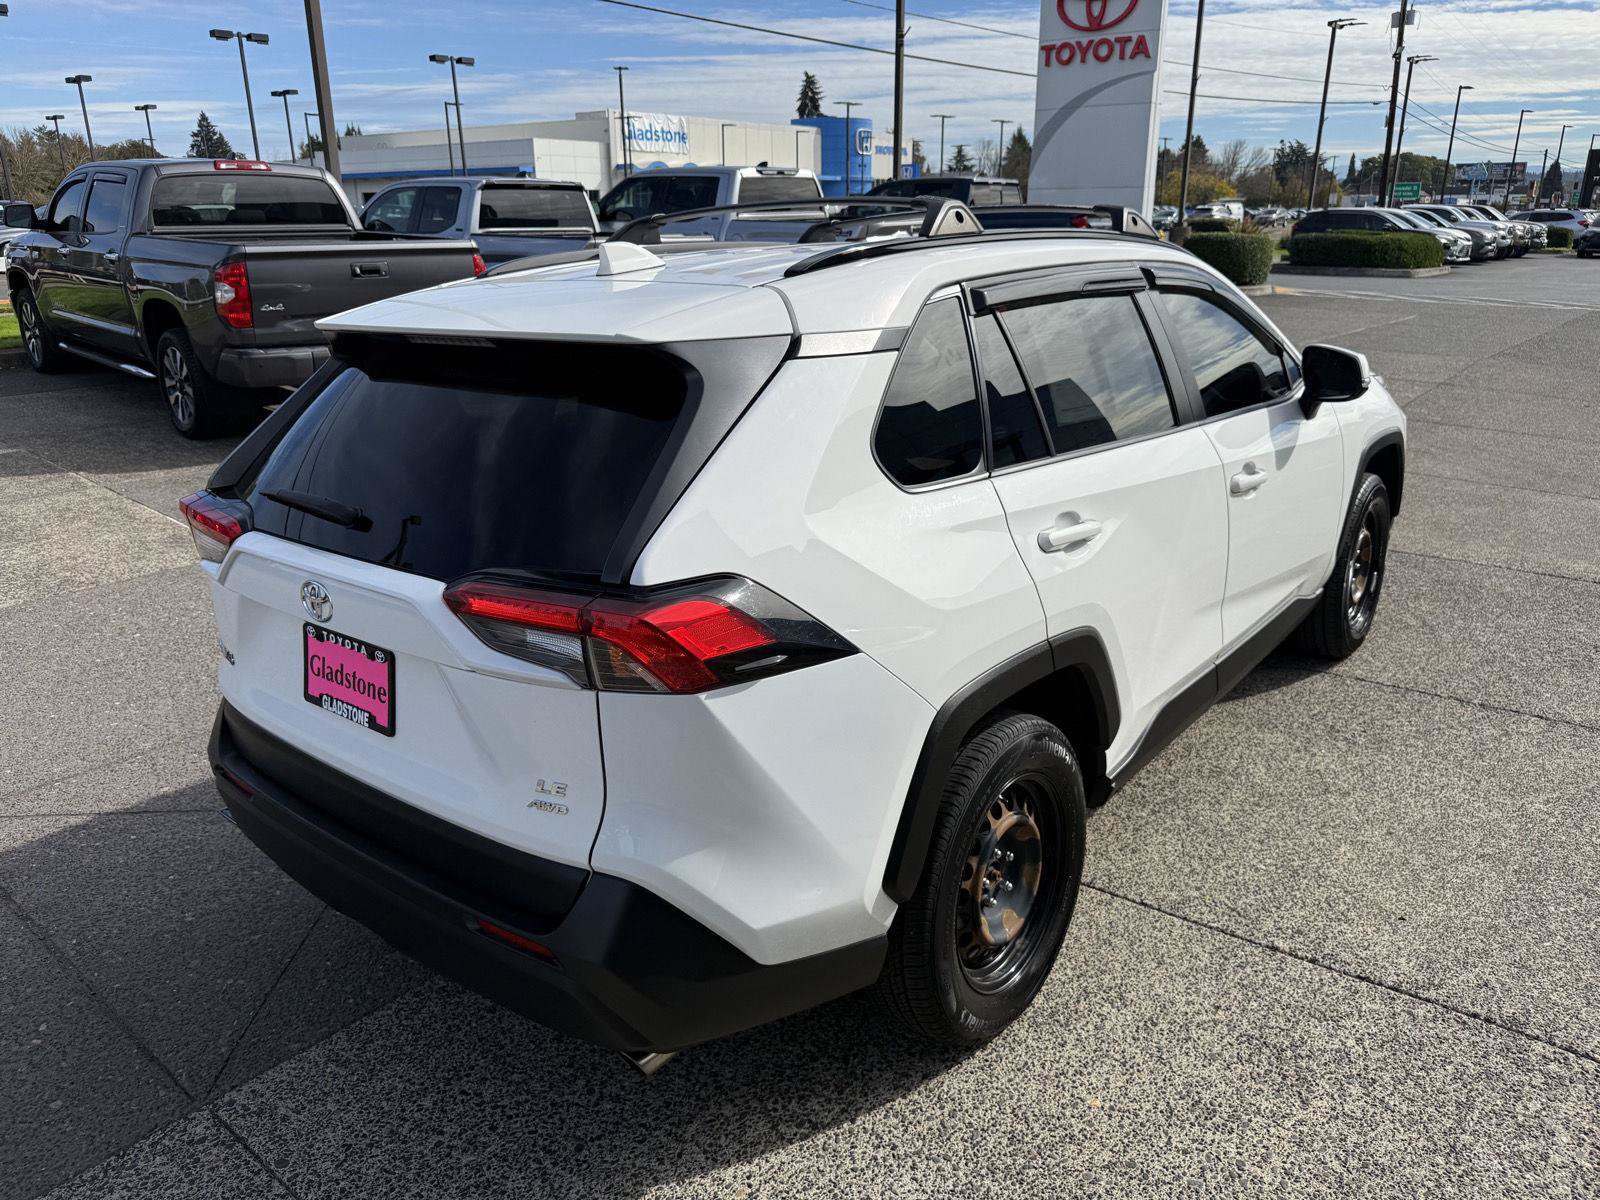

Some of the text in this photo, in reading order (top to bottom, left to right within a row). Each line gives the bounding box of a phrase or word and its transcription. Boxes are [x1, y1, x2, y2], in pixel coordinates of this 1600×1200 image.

[1040, 34, 1151, 67] TOYOTA
[322, 630, 367, 656] TOYOTA
[309, 654, 387, 704] Gladstone
[321, 694, 369, 728] GLADSTONE
[535, 779, 568, 798] LE
[526, 799, 569, 816] AWD
